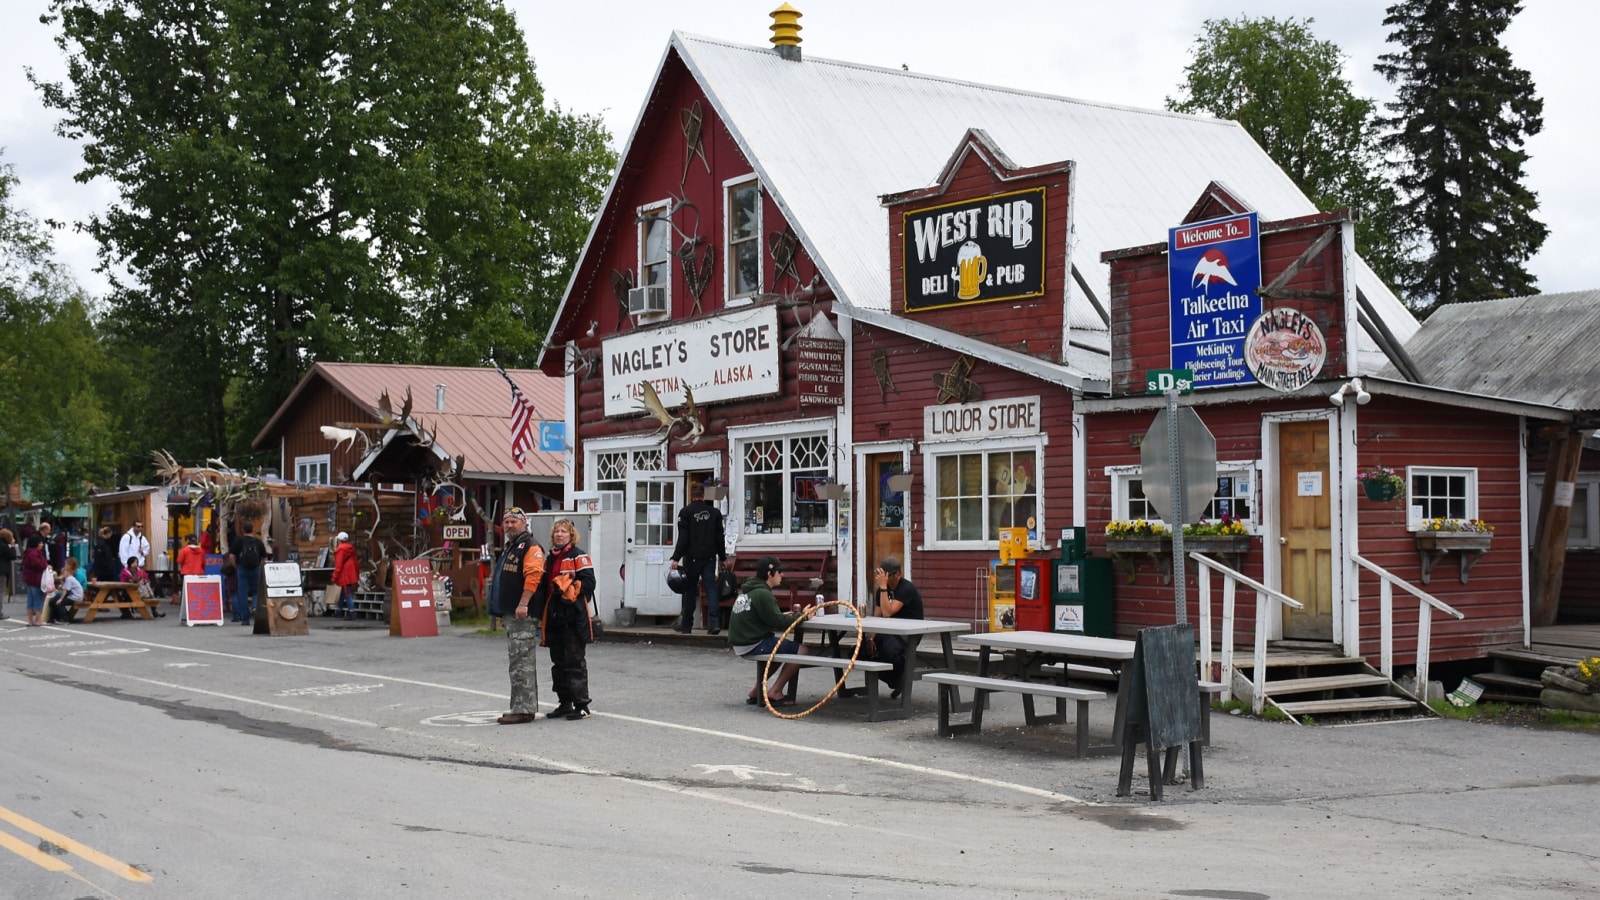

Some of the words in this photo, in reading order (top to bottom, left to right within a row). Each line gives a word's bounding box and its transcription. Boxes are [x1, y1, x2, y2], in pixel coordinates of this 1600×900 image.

[913, 208, 982, 264] WEST
[988, 200, 1033, 250] RIB
[1182, 226, 1223, 245] Welcome
[922, 275, 948, 295] DELI
[986, 273, 994, 287] &
[996, 264, 1025, 286] PUB
[1180, 291, 1249, 316] Talkeetna
[1187, 319, 1209, 339] Air
[1212, 314, 1245, 336] Taxi
[611, 338, 688, 376] NAGLEY'S
[710, 324, 770, 358] STORE
[799, 351, 842, 361] AMMUNITION
[1196, 342, 1236, 358] McKinley
[798, 362, 829, 371] FOUNTAIN
[1227, 355, 1245, 366] Tour
[713, 364, 753, 386] ALASKA
[820, 374, 845, 384] TACKLE
[1158, 373, 1174, 391] D
[1192, 371, 1212, 382] lacier
[1213, 368, 1246, 381] Landings
[814, 384, 829, 393] ICE
[799, 394, 843, 405] SANDWICHES
[932, 407, 982, 435] LIQUOR
[988, 402, 1036, 431] STORE
[586, 500, 598, 511] ICE
[445, 527, 470, 538] OPEN
[395, 563, 430, 575] Kettle
[399, 575, 428, 586] Korn
